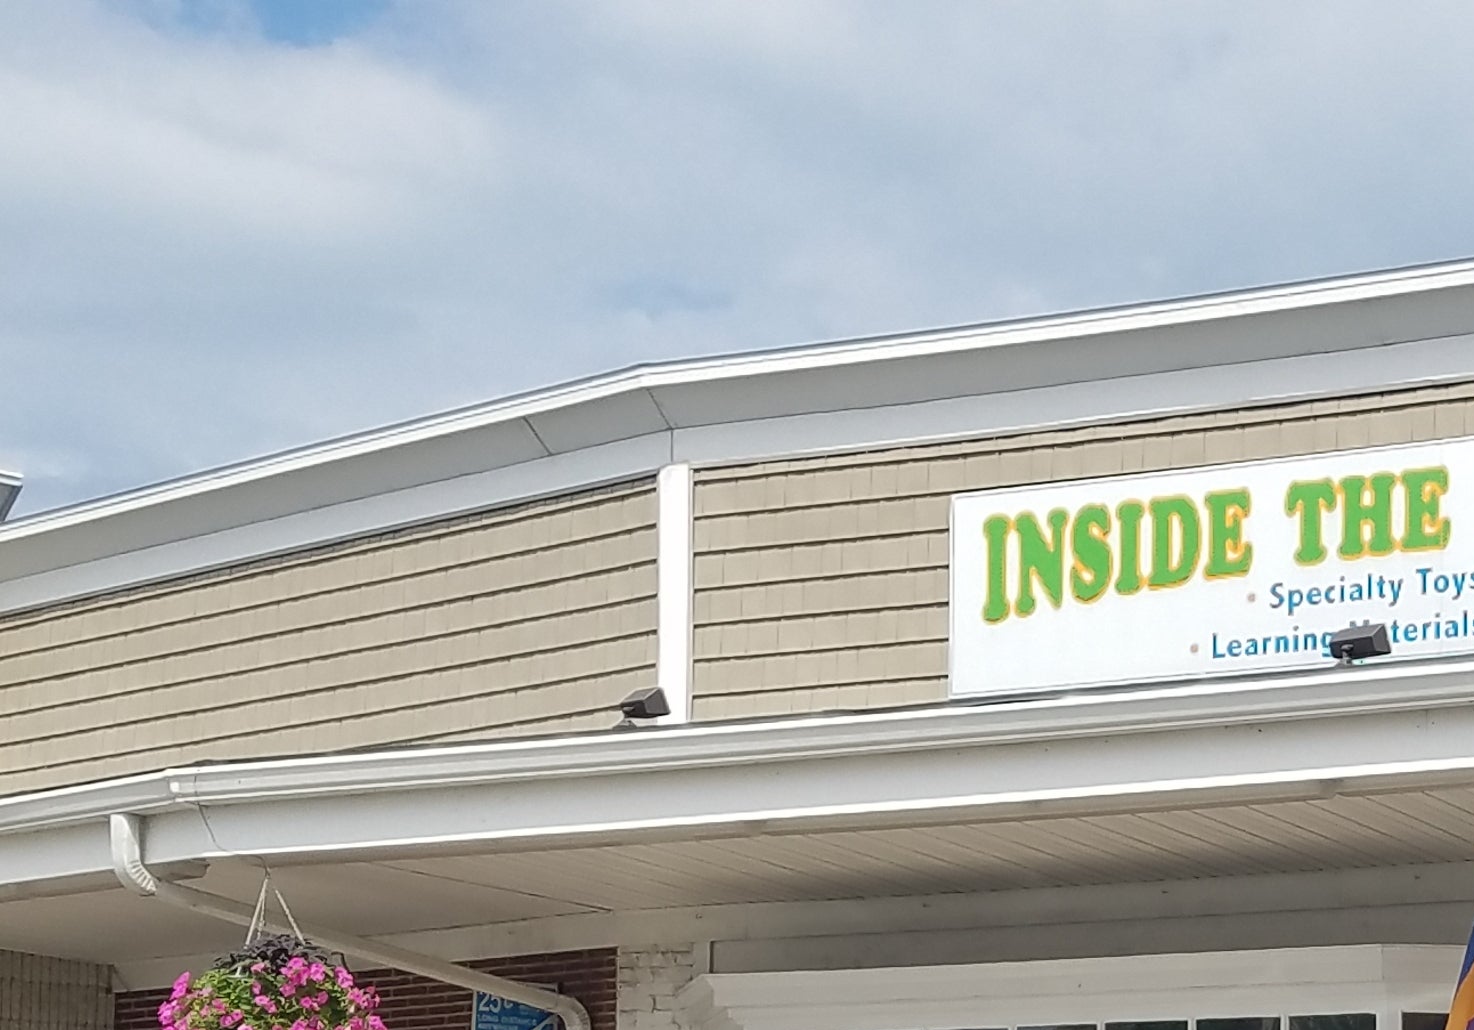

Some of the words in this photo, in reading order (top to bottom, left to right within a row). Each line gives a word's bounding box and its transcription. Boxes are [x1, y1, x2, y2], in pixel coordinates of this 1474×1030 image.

[981, 486, 1253, 624] INSIDE
[1285, 465, 1451, 566] THE
[1269, 573, 1403, 616] Specialty
